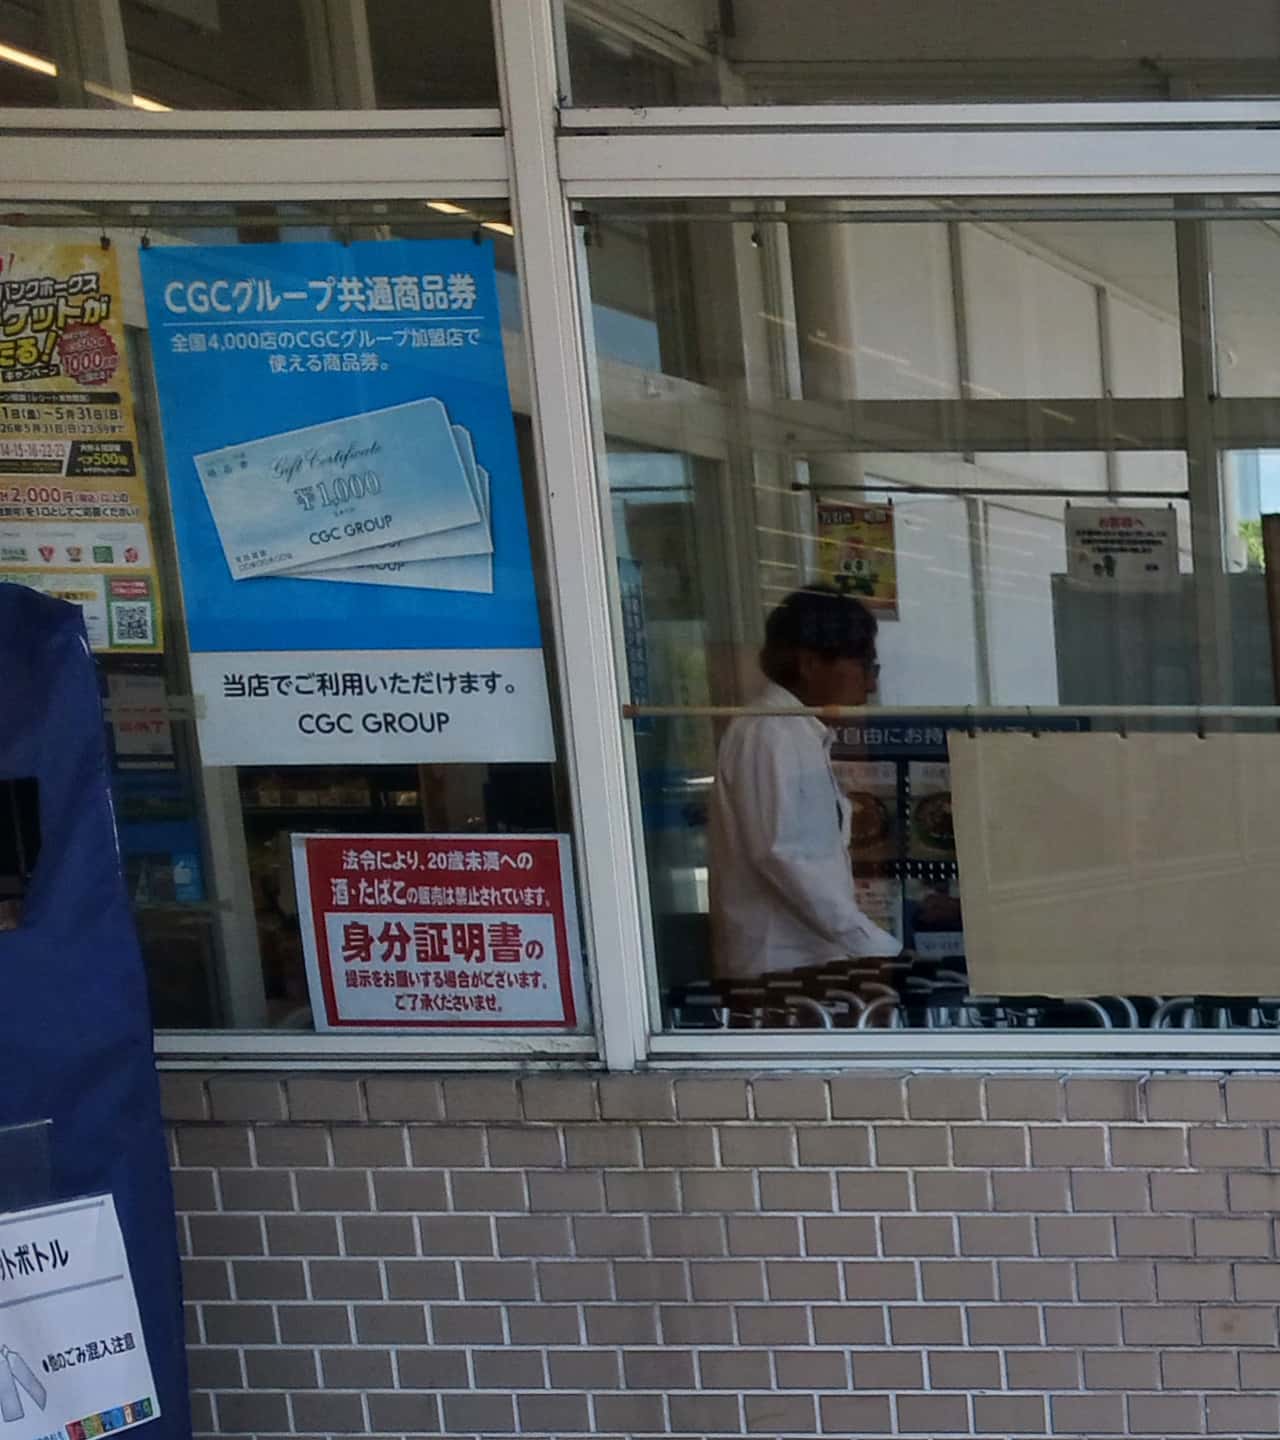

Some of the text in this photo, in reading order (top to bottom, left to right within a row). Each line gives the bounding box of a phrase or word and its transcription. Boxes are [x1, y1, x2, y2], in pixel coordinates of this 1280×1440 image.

[164, 274, 477, 313] CGCグループ共通商品券
[170, 327, 481, 352] 全国4,000店のCGCグループ加盟店で
[268, 352, 390, 373] 使える商品券。
[309, 514, 393, 545] CGC GROUP
[223, 672, 515, 698] 当店でご利用いただけます。
[298, 711, 450, 734] CGC GROUP
[838, 727, 945, 745] 自由にお持
[342, 850, 533, 871] 法令により、20歳未満への
[341, 922, 544, 962] 身分証明書の
[345, 971, 548, 989] 提示をお願いする場合がございます。
[395, 994, 502, 1011] ご了承くださいませ。
